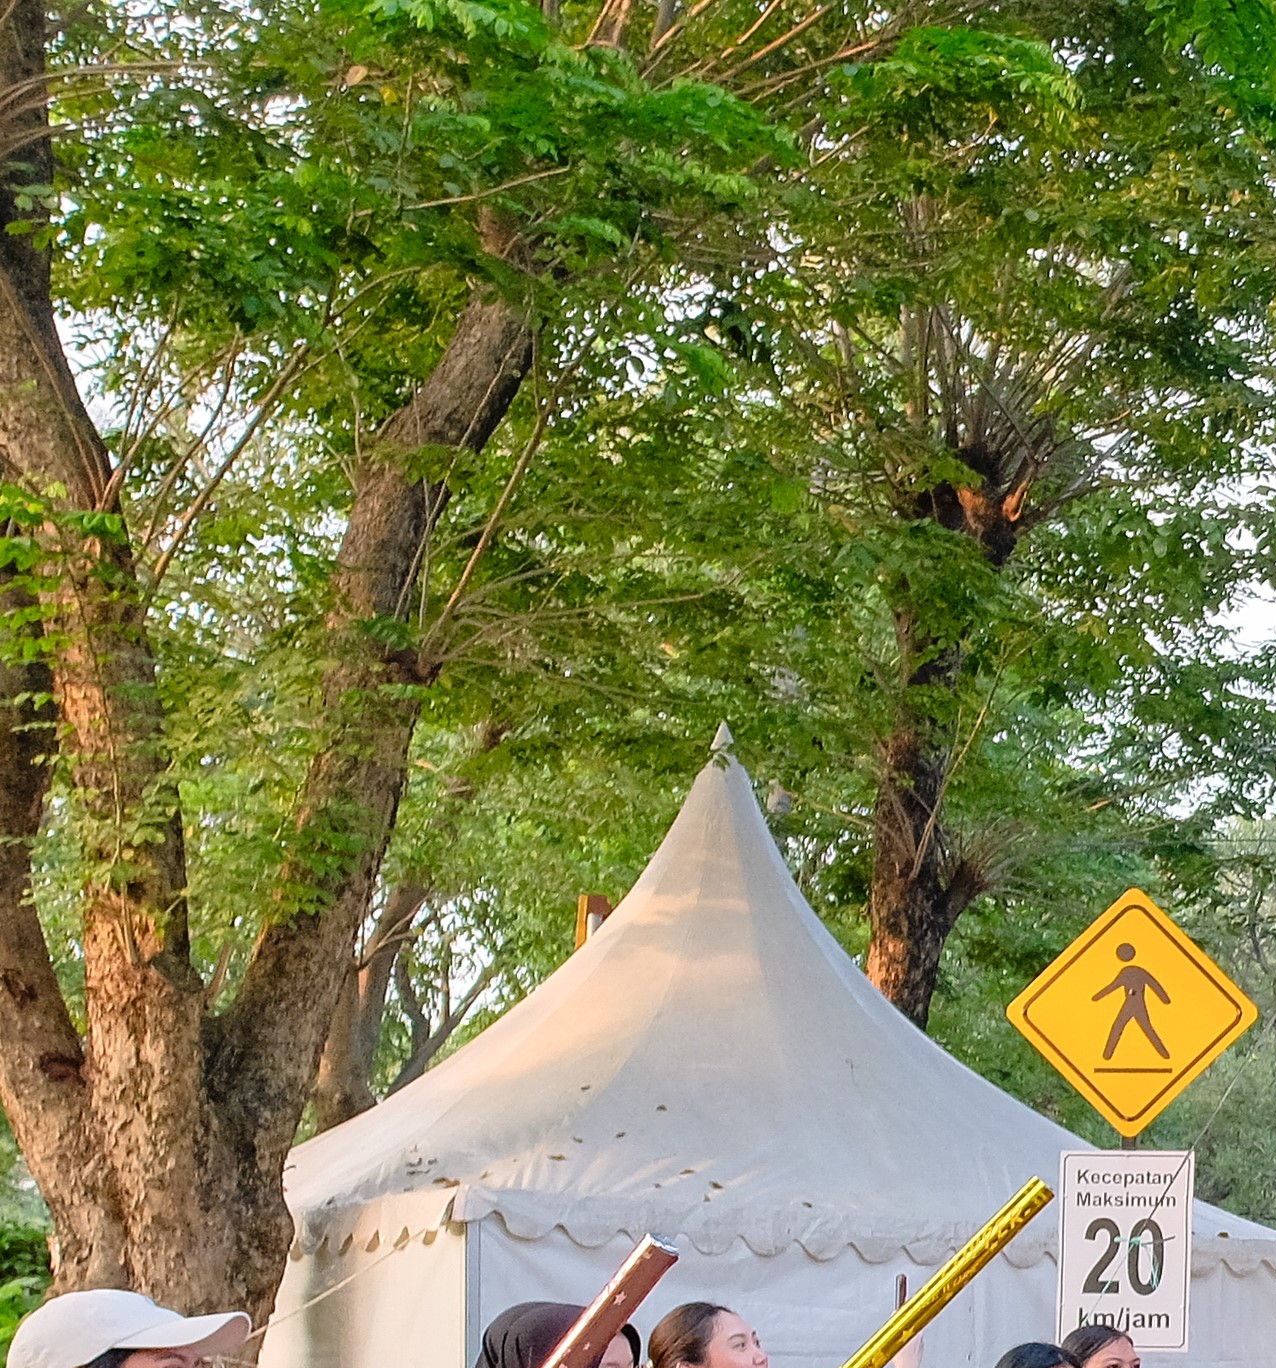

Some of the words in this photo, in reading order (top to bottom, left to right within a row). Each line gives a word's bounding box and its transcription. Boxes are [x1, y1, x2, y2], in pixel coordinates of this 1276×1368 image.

[1077, 1169, 1174, 1188] Kecepatan
[1076, 1192, 1177, 1208] Maksimum
[1082, 1218, 1165, 1295] 20
[1078, 1307, 1170, 1332] km/jam
